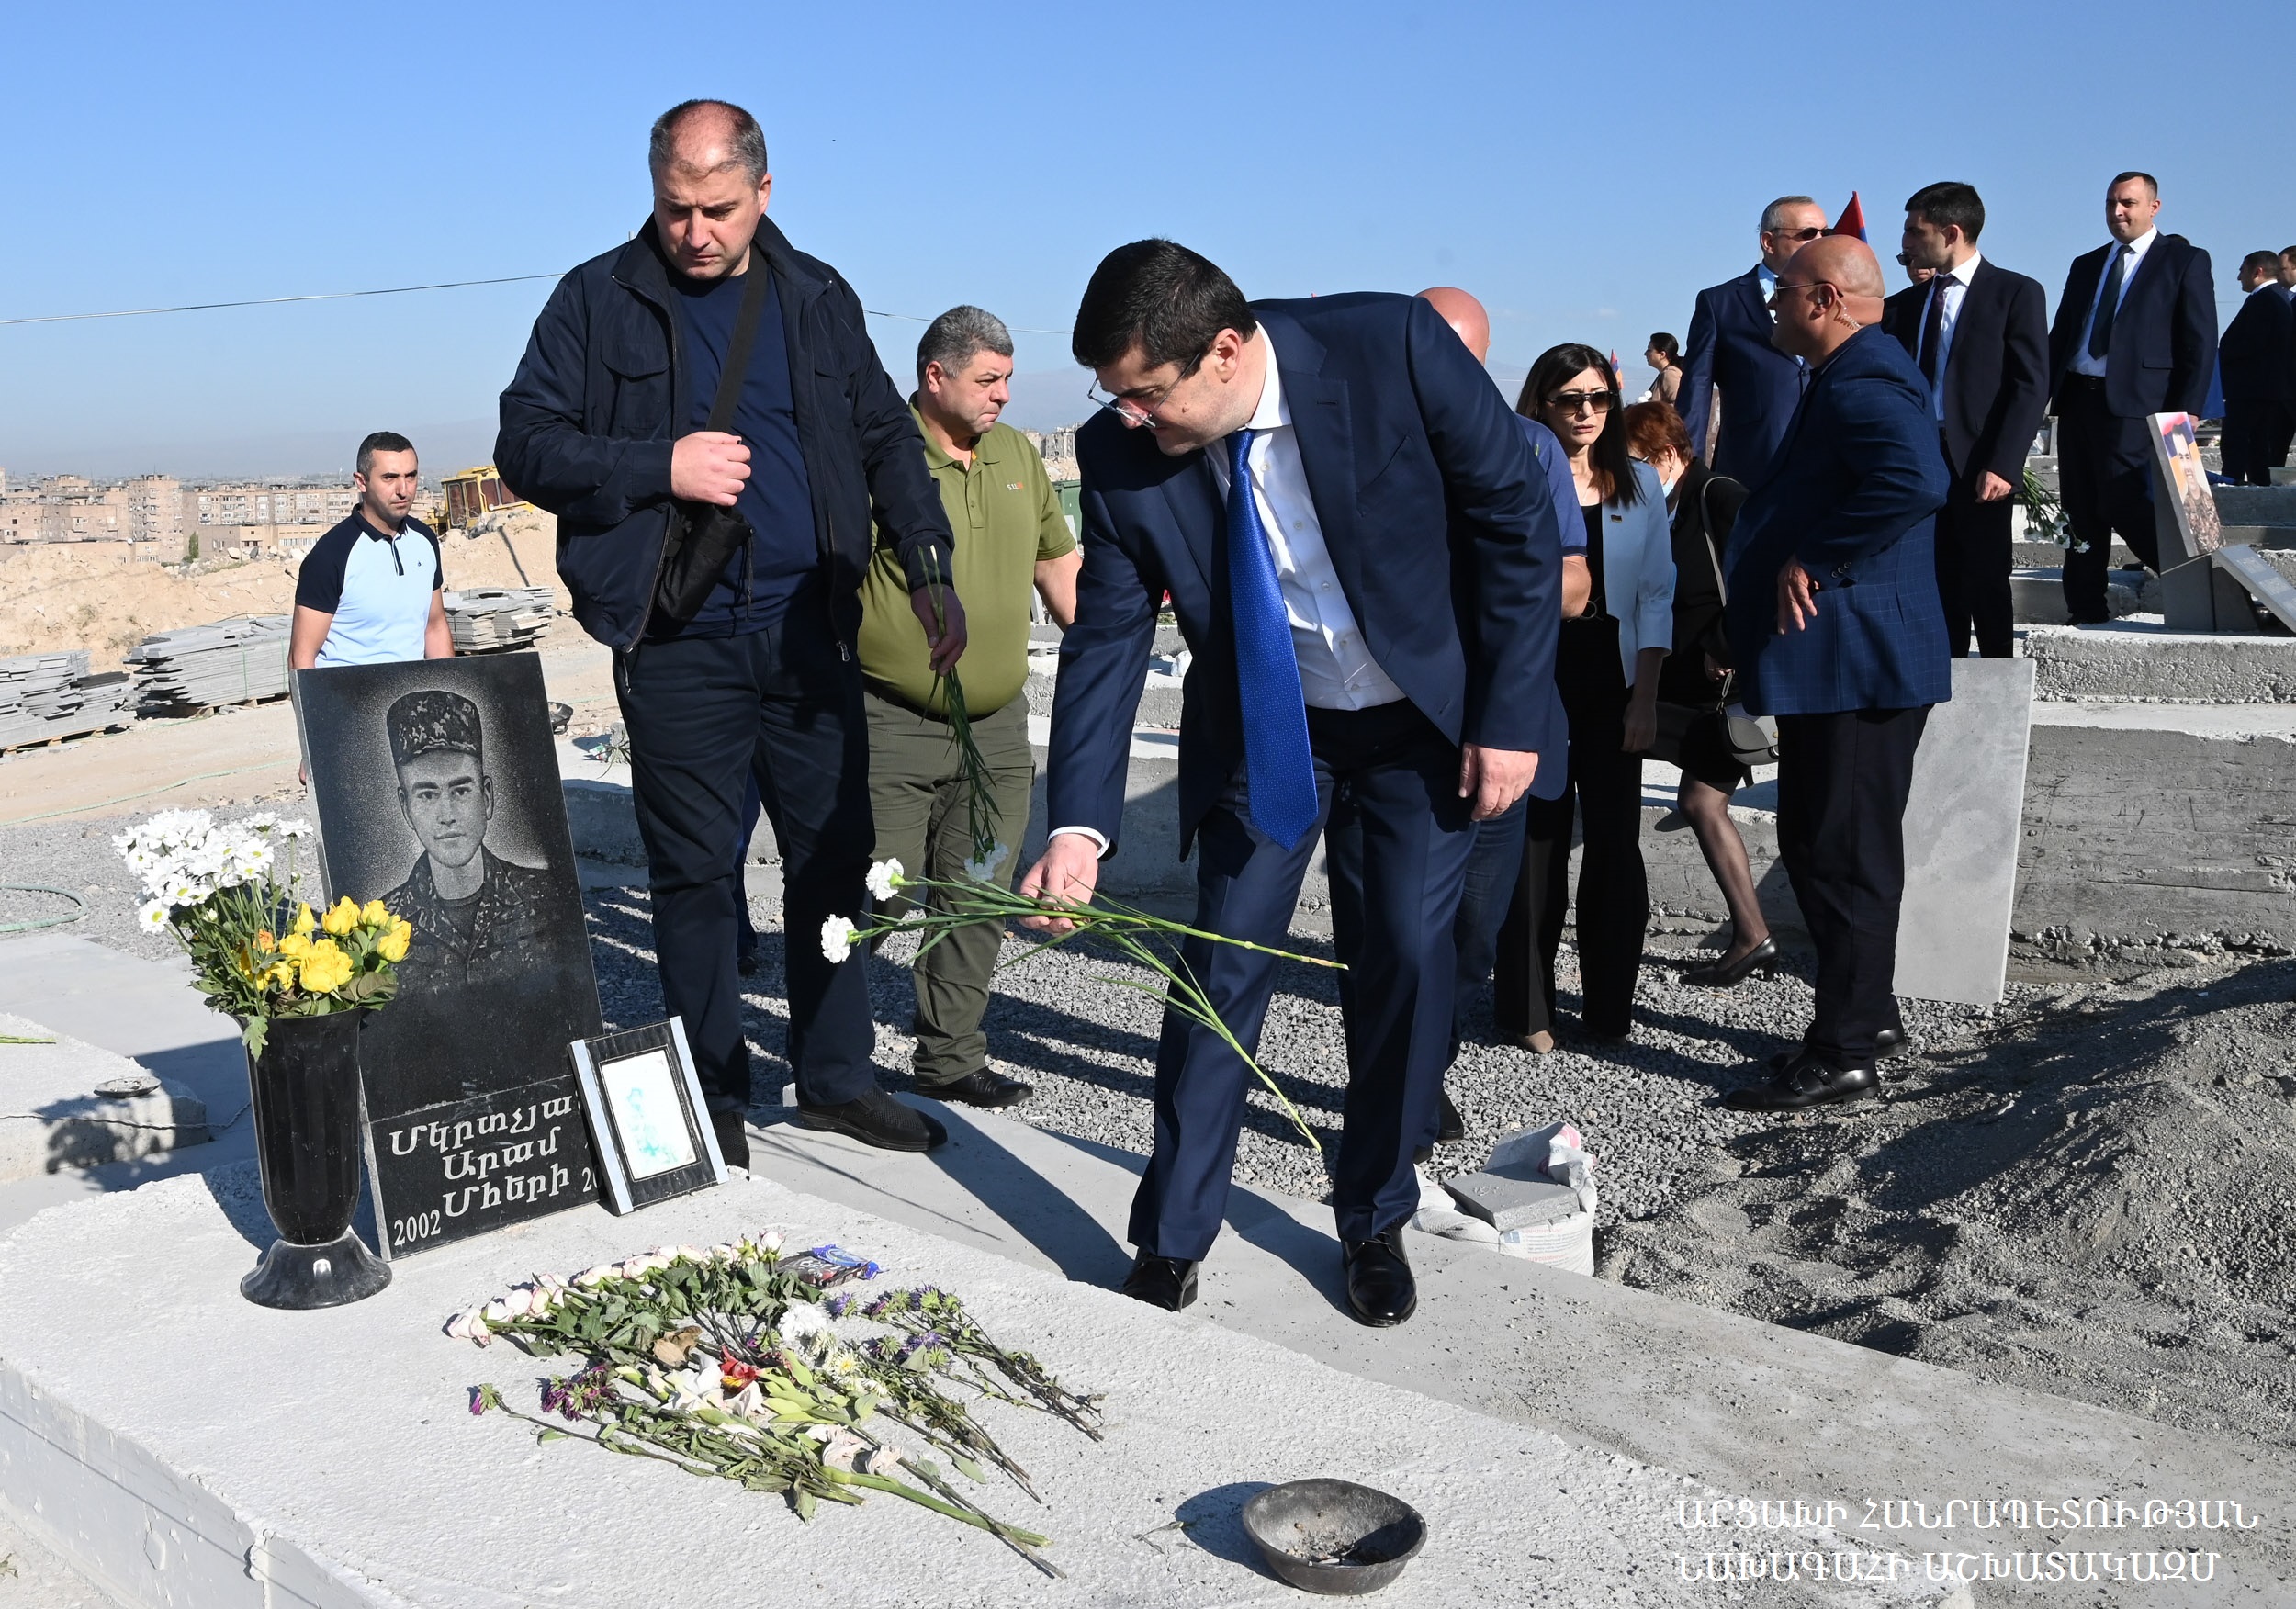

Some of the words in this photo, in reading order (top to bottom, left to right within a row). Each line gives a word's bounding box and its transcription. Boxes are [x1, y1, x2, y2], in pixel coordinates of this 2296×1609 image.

[388, 1090, 581, 1156] Մկրտչյա
[442, 1125, 562, 1181] Արամ
[442, 1162, 570, 1218] Մհերի
[393, 1209, 442, 1247] 2002
